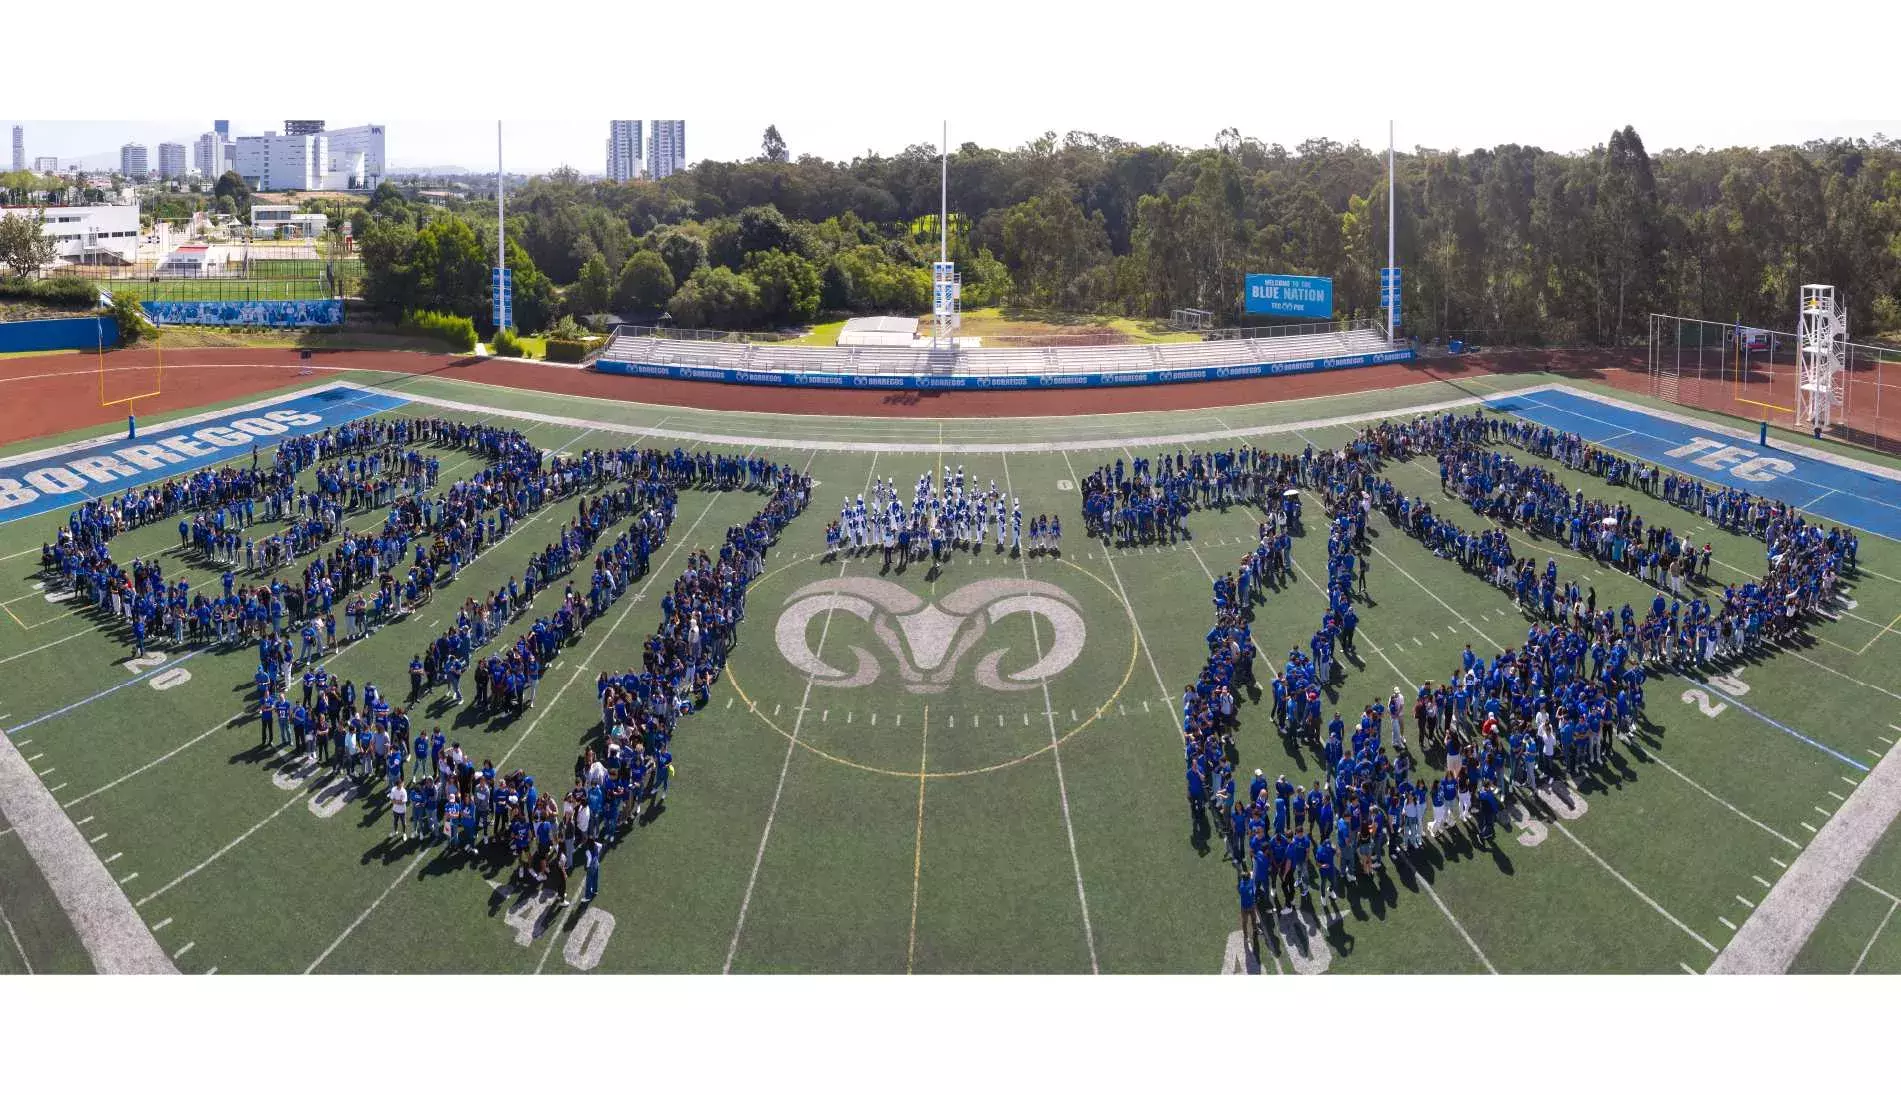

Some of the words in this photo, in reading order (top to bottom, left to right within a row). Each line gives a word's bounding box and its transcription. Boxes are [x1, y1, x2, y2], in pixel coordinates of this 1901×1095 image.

[1252, 286, 1280, 299] BLUE
[1284, 288, 1325, 302] NATION
[868, 378, 904, 386] BORREGOS
[1663, 436, 1797, 482] TEC
[124, 651, 192, 690] 20
[1681, 676, 1750, 719] 20
[504, 885, 616, 971] 40
